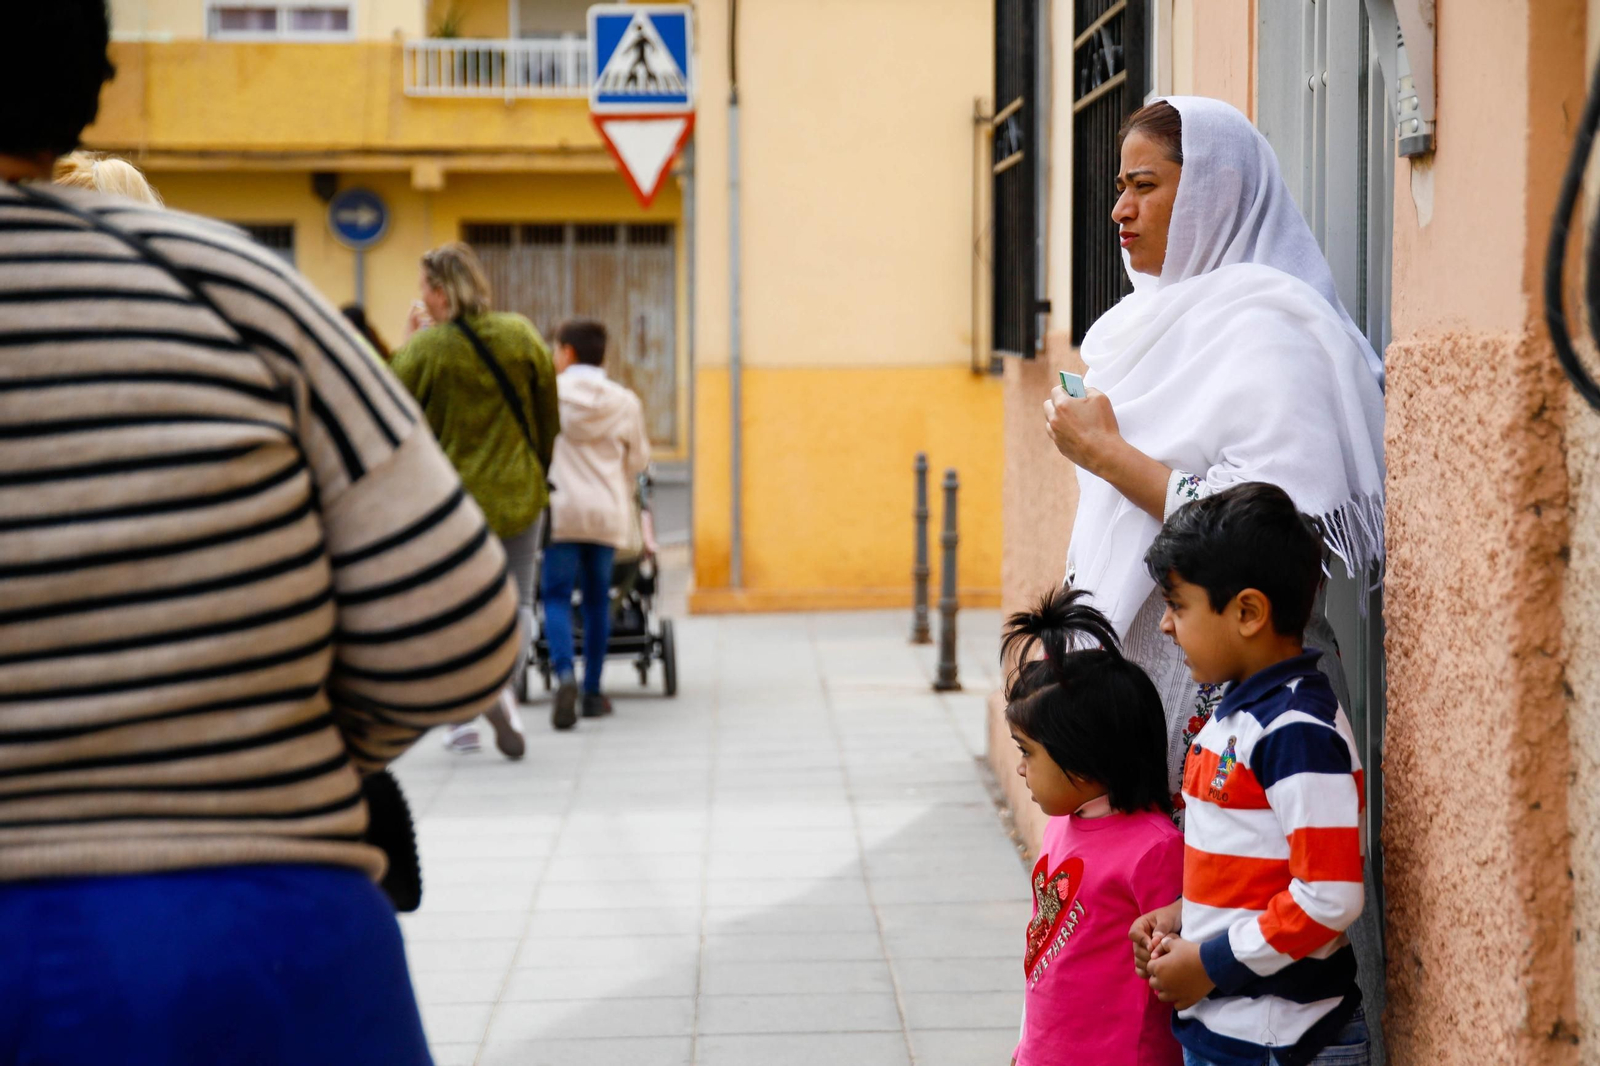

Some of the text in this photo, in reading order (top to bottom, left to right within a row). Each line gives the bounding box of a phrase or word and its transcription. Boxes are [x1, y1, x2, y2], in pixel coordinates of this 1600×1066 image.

[1208, 788, 1229, 802] POLO
[1030, 900, 1085, 990] LOVE THERAPY
